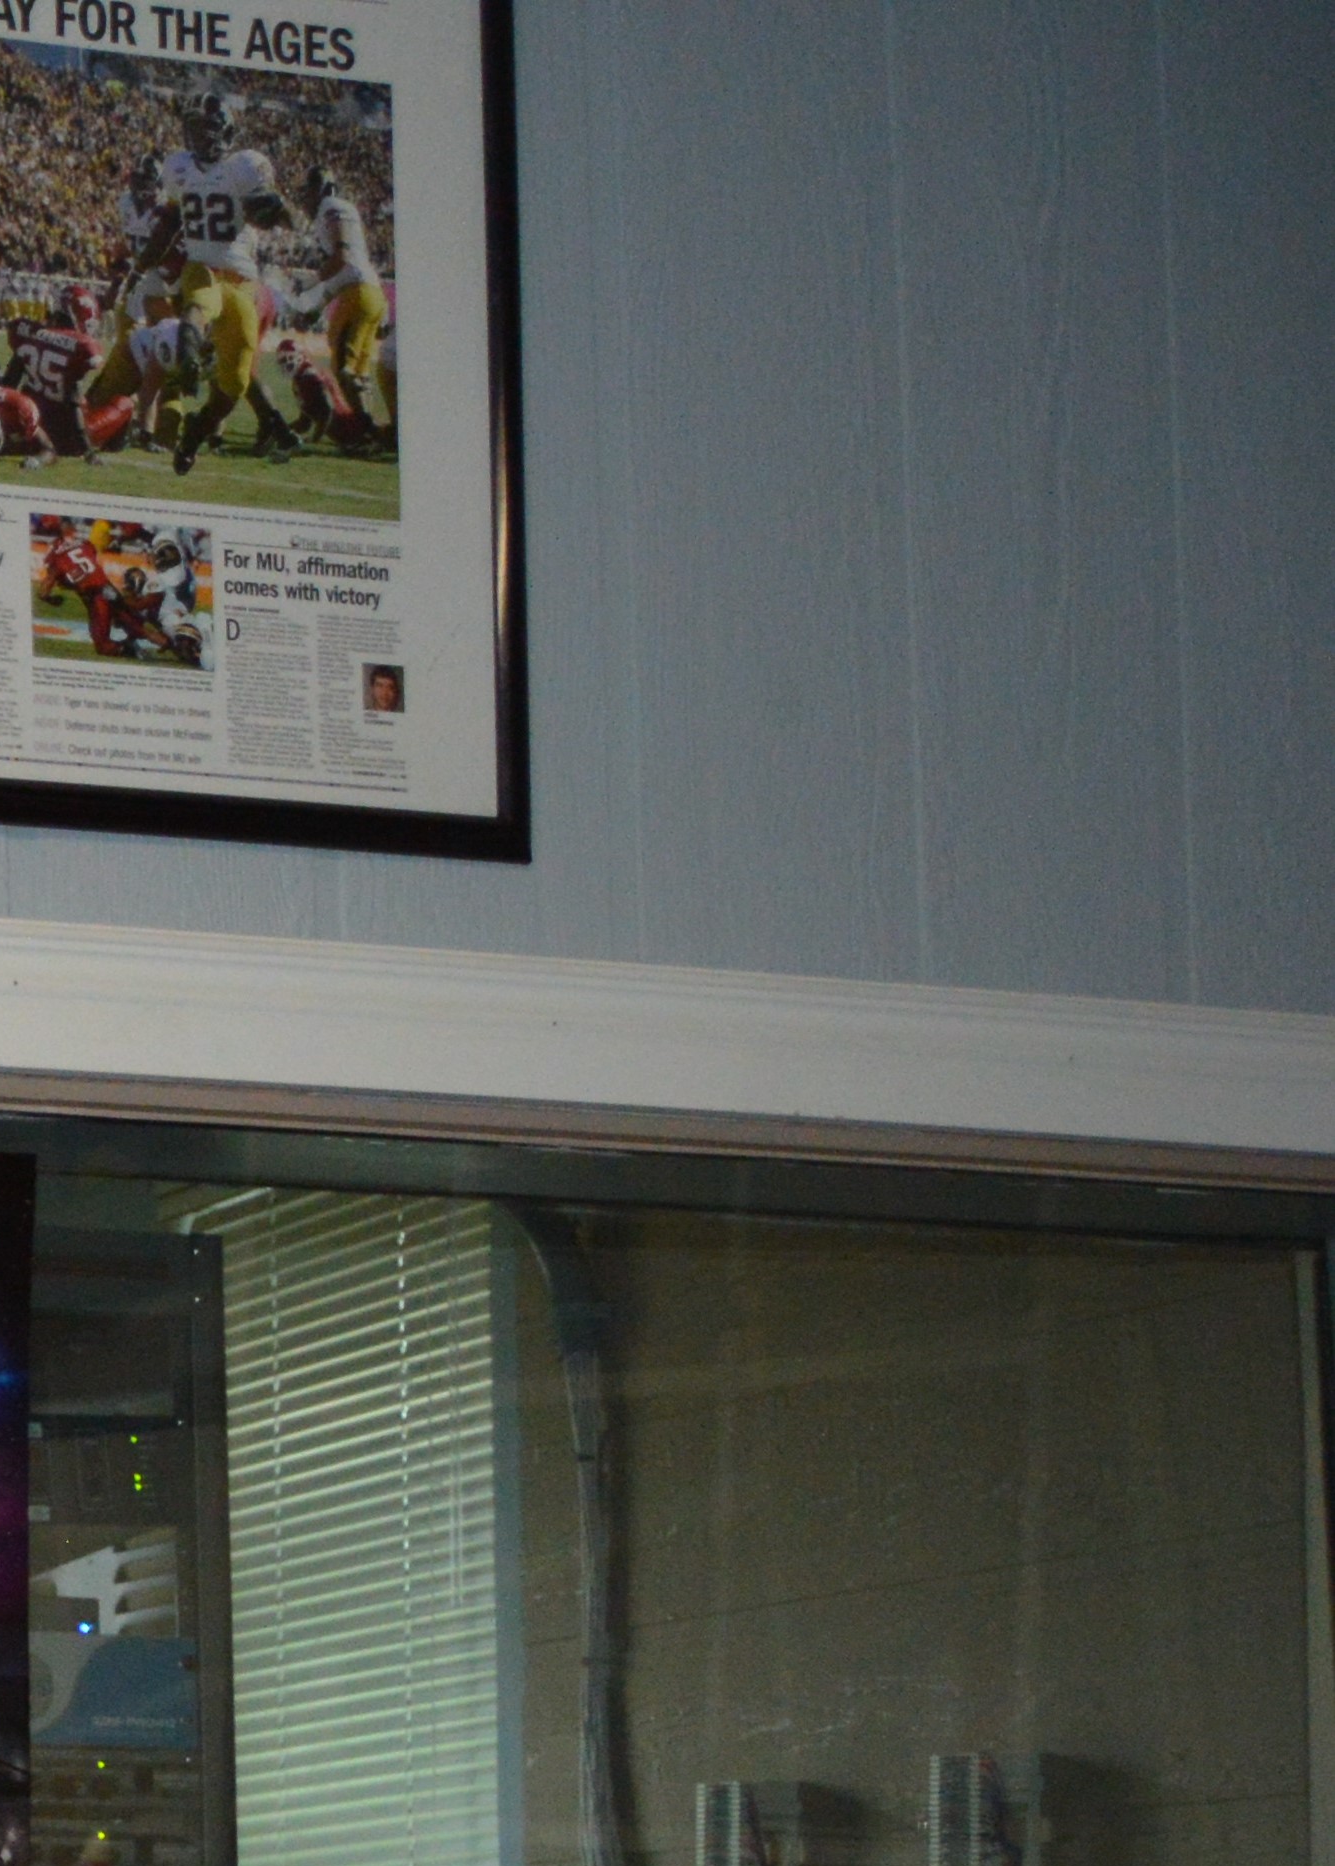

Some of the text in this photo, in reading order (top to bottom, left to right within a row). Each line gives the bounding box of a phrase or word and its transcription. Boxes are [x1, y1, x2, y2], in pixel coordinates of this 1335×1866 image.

[55, 0, 137, 46] FOR
[150, 6, 231, 58] THE
[243, 18, 356, 71] AGES
[182, 191, 238, 242] 22
[223, 548, 391, 583] For MU, affirmation
[224, 578, 382, 612] comes with victory
